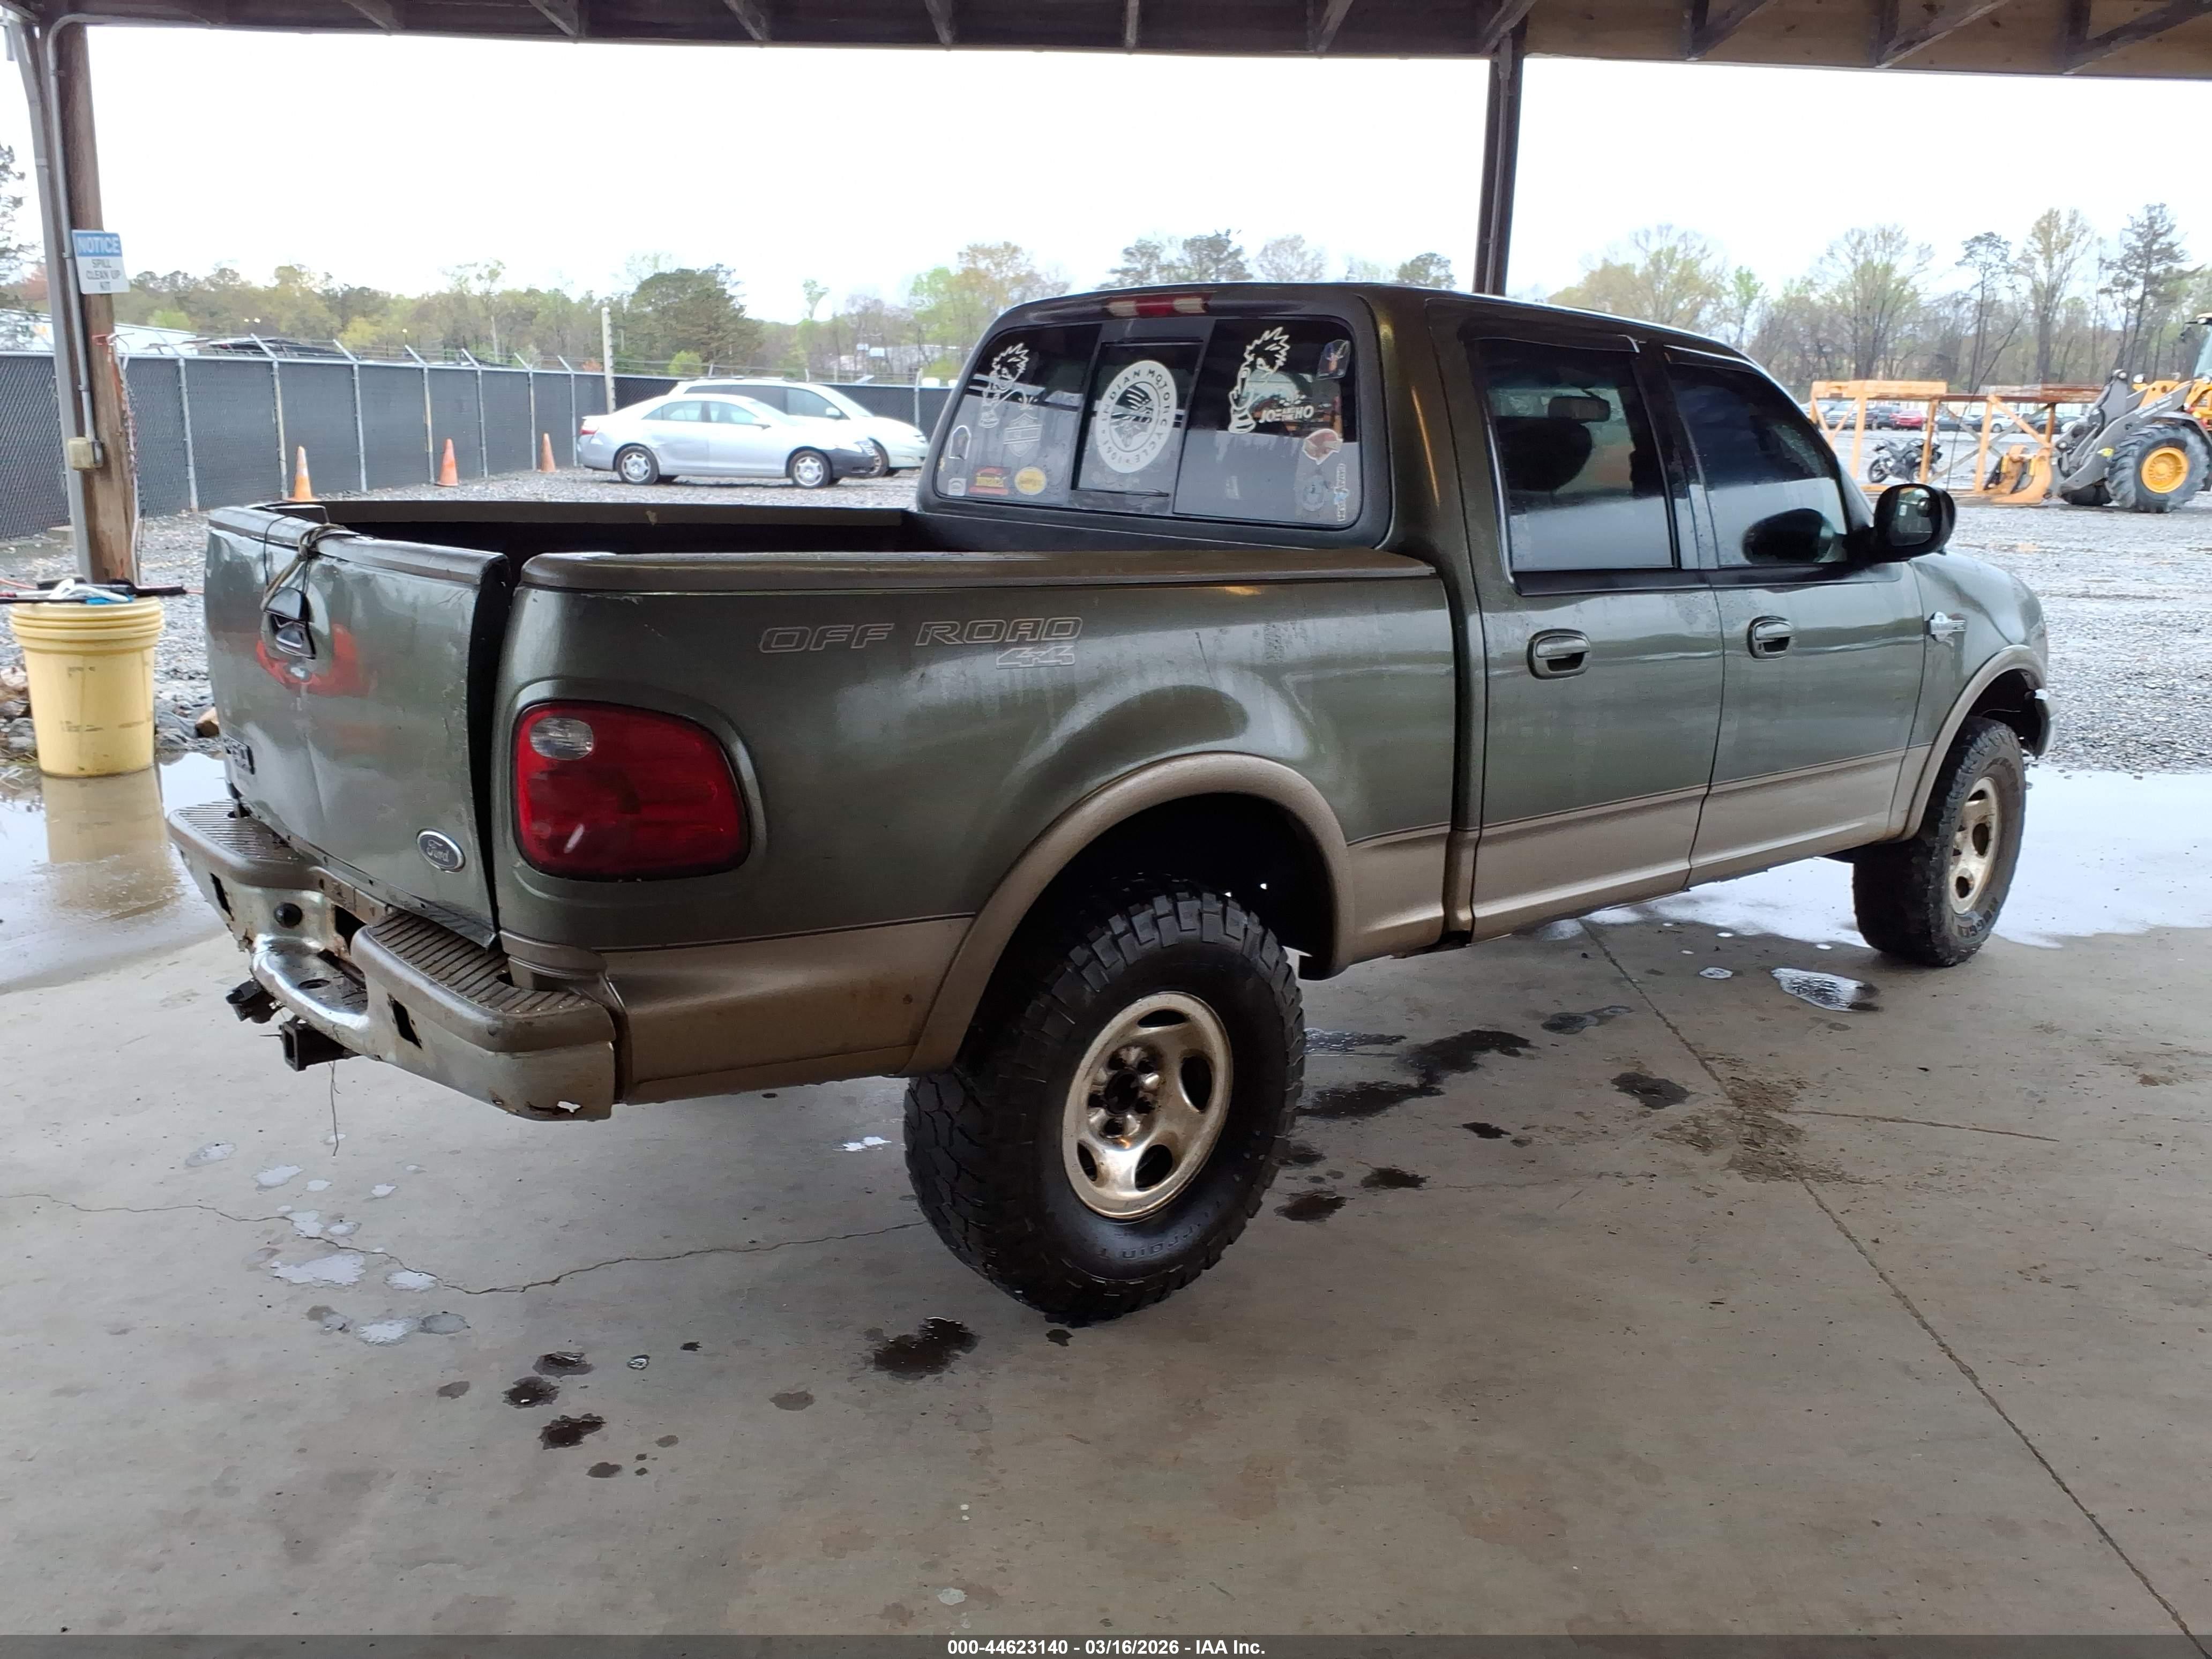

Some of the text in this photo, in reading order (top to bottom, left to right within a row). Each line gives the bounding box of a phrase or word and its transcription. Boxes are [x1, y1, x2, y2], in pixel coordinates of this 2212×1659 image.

[77, 236, 120, 254] NOTICE
[91, 259, 111, 268] SPILL
[86, 270, 121, 280] CLEAN UP
[1101, 369, 1141, 422] INDIAN
[1134, 369, 1170, 463] MOTORCYCLE
[1259, 408, 1282, 423] JOE
[759, 617, 1083, 653] OFF ROAD
[427, 840, 450, 862] Ford
